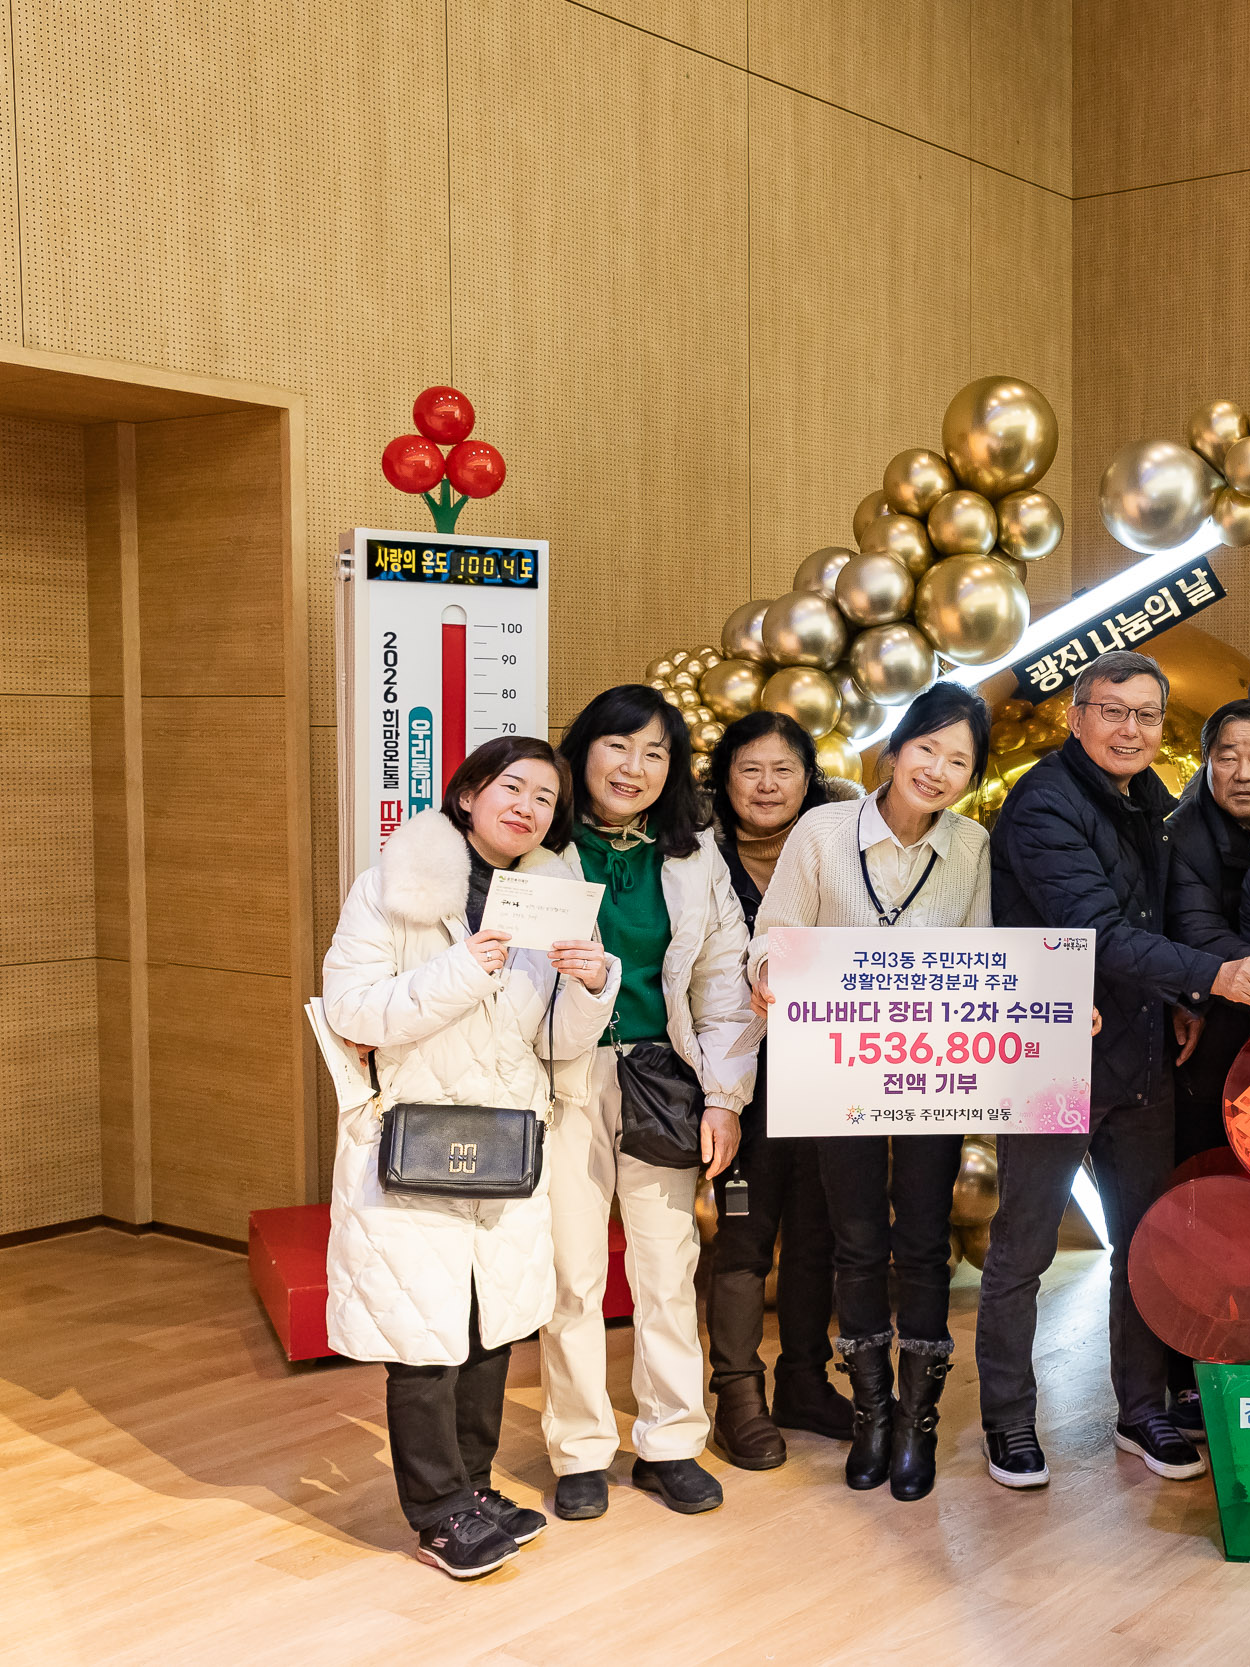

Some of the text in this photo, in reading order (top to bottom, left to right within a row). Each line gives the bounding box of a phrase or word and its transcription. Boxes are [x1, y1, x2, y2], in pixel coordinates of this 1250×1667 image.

[375, 548, 416, 573] 사랑의
[421, 550, 448, 574] 온도
[501, 624, 523, 634] 100
[1025, 567, 1216, 692] 광진 나눔의 날
[383, 632, 398, 704] 2026
[501, 654, 517, 665] 90
[502, 689, 517, 699] 80
[502, 723, 517, 733] 70
[411, 719, 431, 799] 우리동네
[852, 951, 1007, 969] 구의3동 주민자치회
[840, 973, 1018, 991] 생활안전환경분과 주관
[787, 1001, 1074, 1024] 아나바다 장터 1·2차 수익금
[829, 1032, 1040, 1067] 1,536,800원
[883, 1073, 978, 1095] 전액 기부
[870, 1108, 1012, 1122] 구의3동 주민자치회 일동
